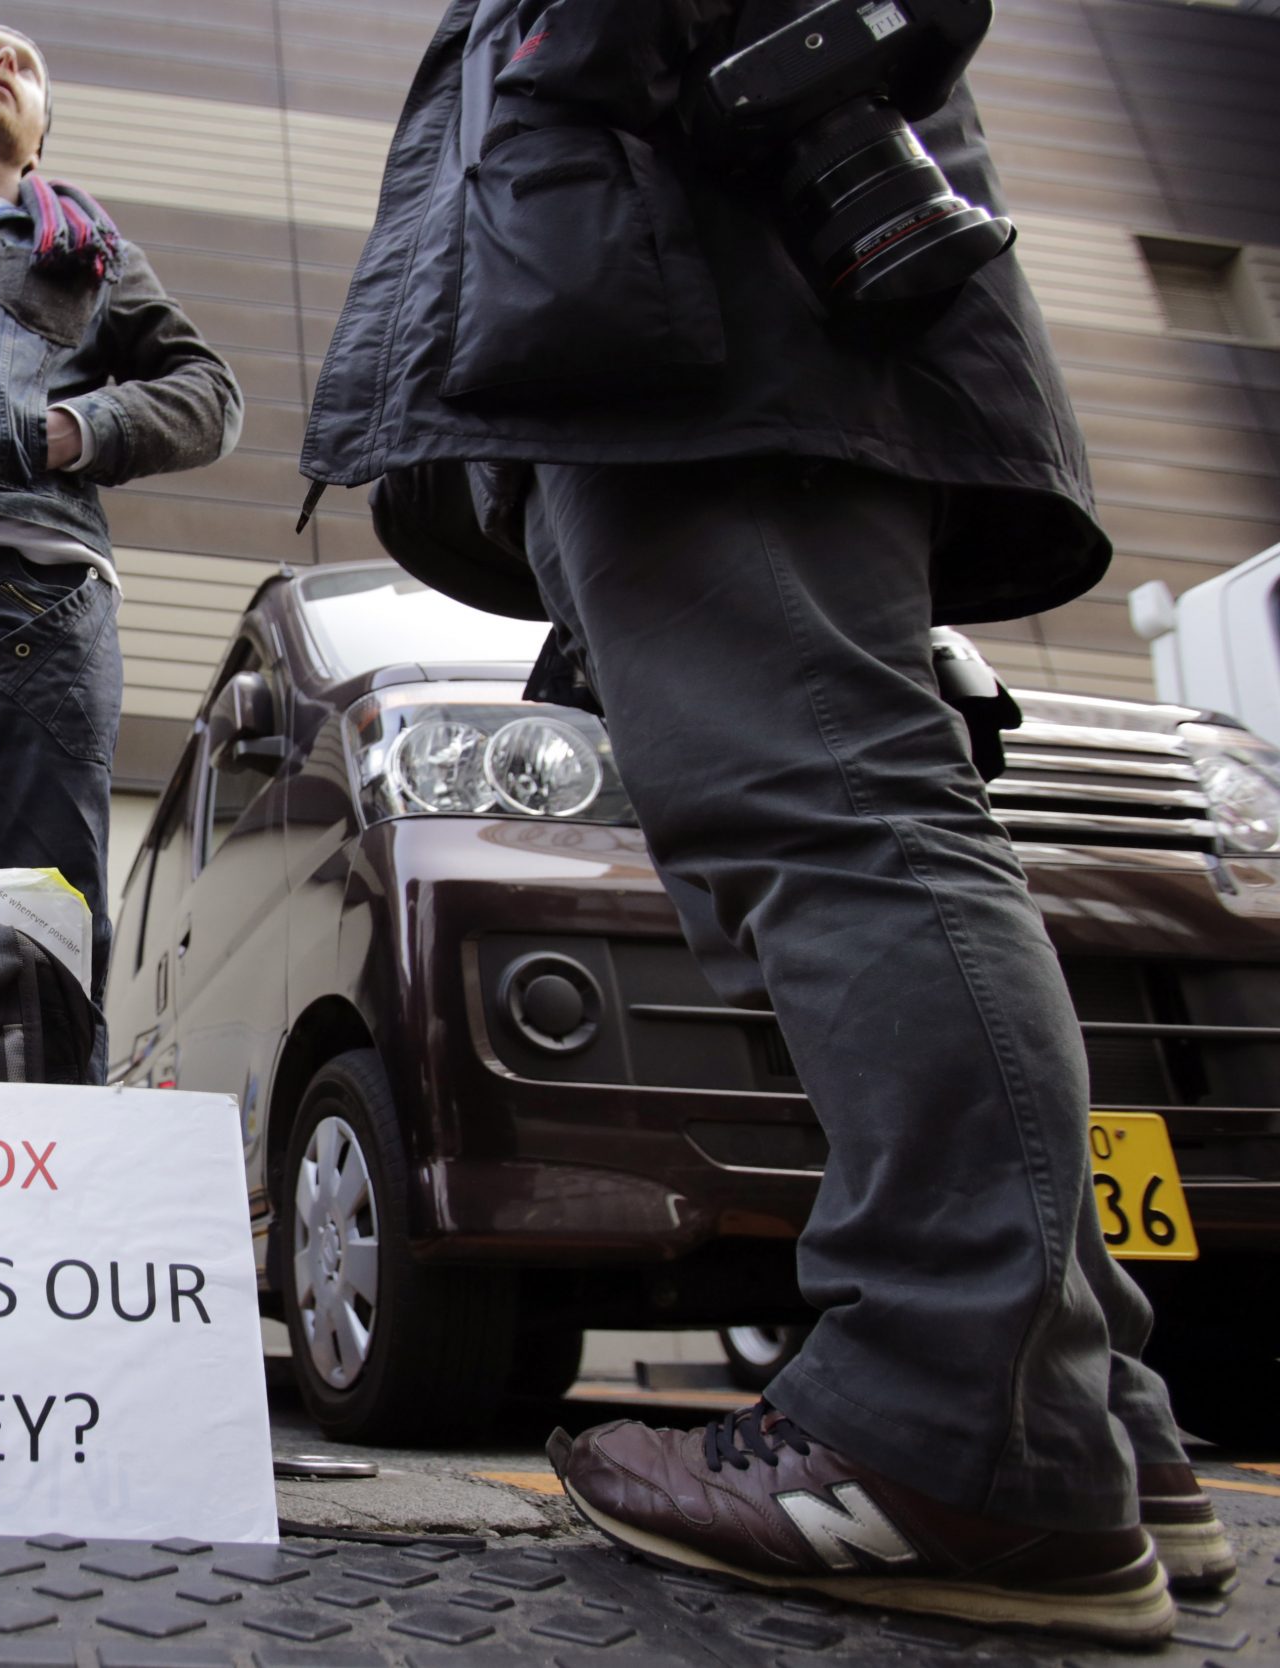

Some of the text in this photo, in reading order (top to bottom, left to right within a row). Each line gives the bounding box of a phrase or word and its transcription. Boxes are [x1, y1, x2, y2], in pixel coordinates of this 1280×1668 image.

[8, 897, 50, 929] whenever
[48, 926, 81, 956] possible
[45, 1258, 212, 1325] OUR
[774, 1480, 919, 1570] N
